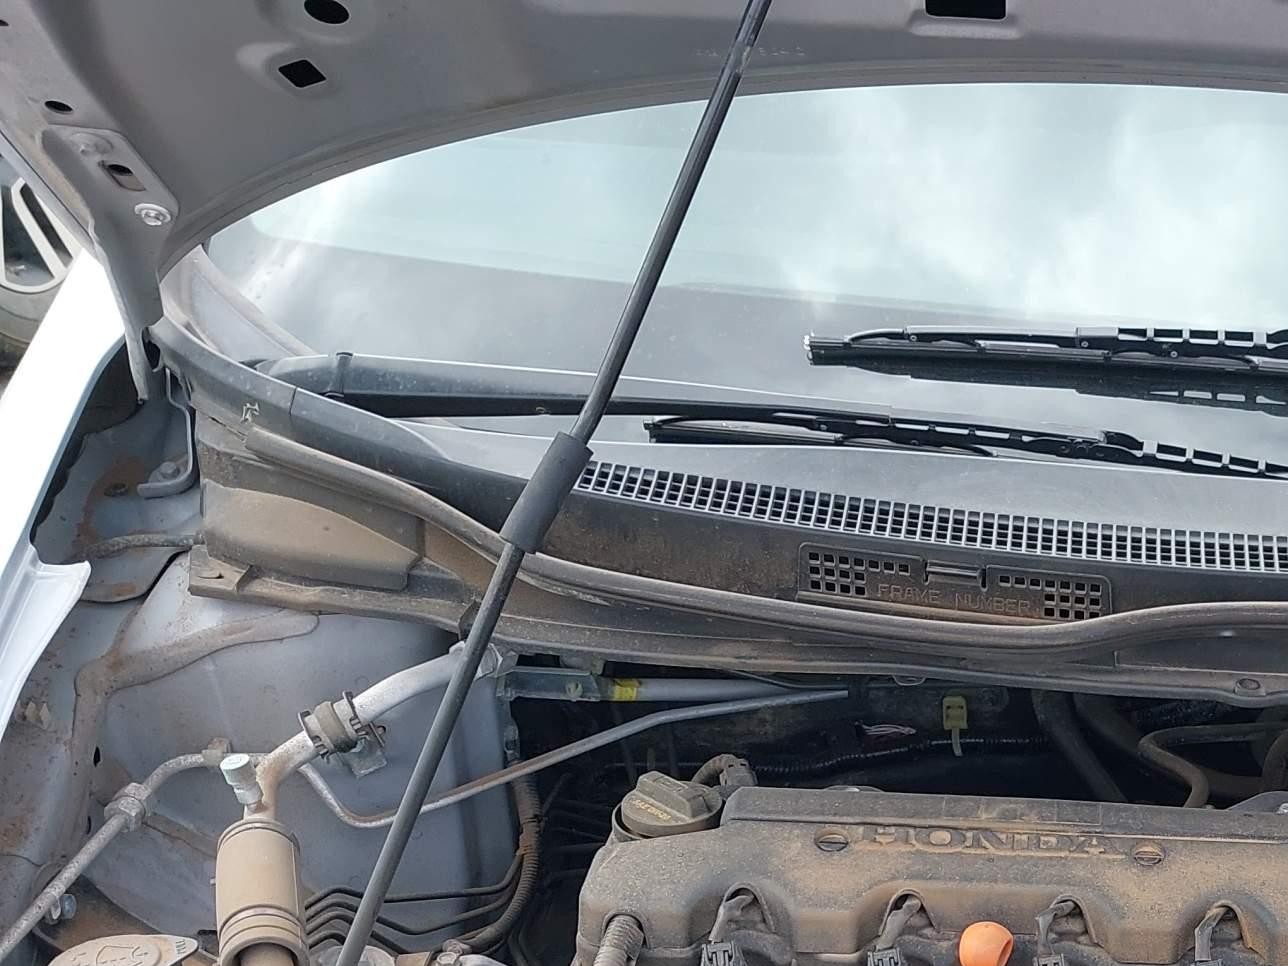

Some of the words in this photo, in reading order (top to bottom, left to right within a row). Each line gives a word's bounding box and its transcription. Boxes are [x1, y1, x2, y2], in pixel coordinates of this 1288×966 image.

[877, 583, 941, 604] FRAME
[954, 592, 1032, 618] NUMBER
[861, 825, 1119, 857] HONDA
